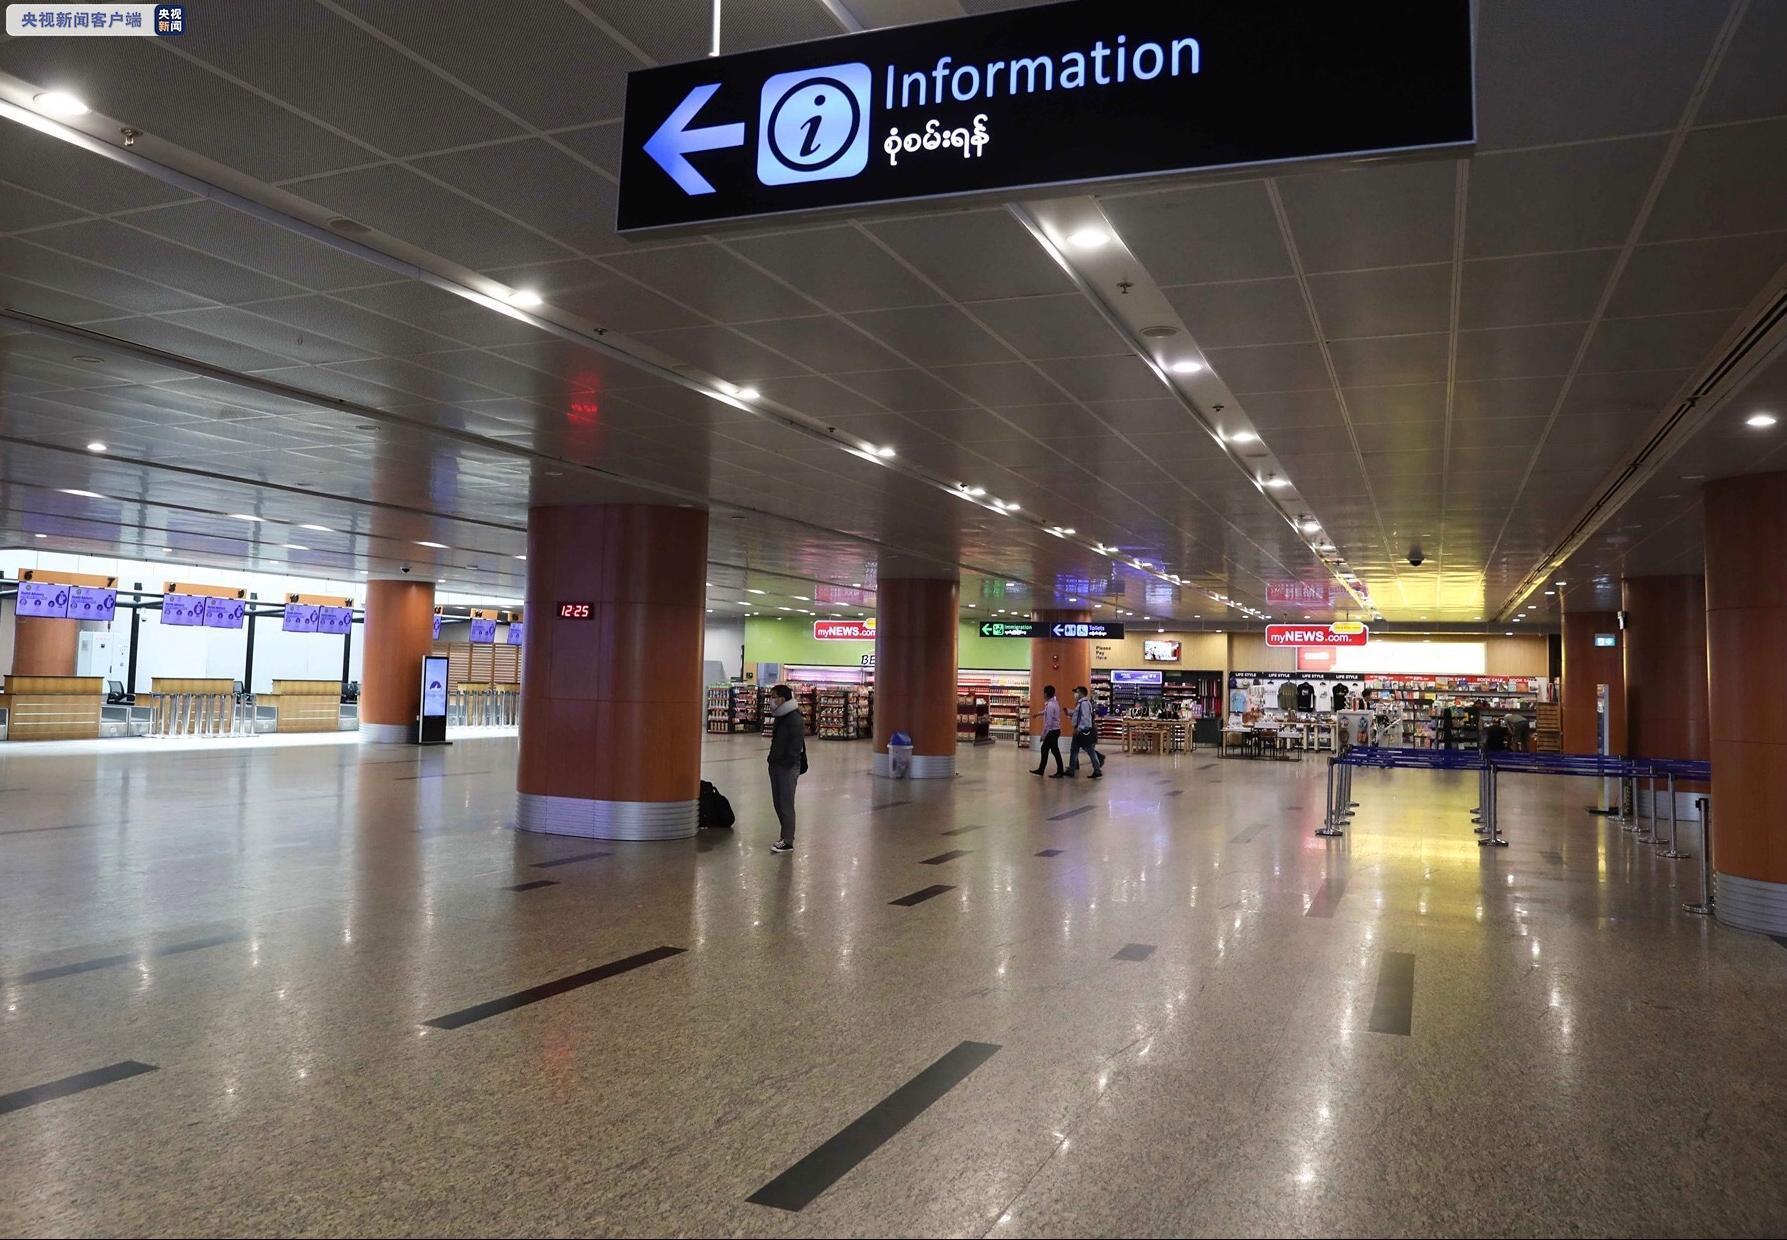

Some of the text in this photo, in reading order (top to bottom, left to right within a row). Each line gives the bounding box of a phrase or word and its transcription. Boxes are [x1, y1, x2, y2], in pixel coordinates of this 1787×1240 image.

[886, 35, 1200, 110] Information
[884, 113, 990, 166] စုံစမ်းရန်
[24, 570, 34, 581] 6
[107, 577, 116, 587] 7
[561, 604, 589, 617] 12:25
